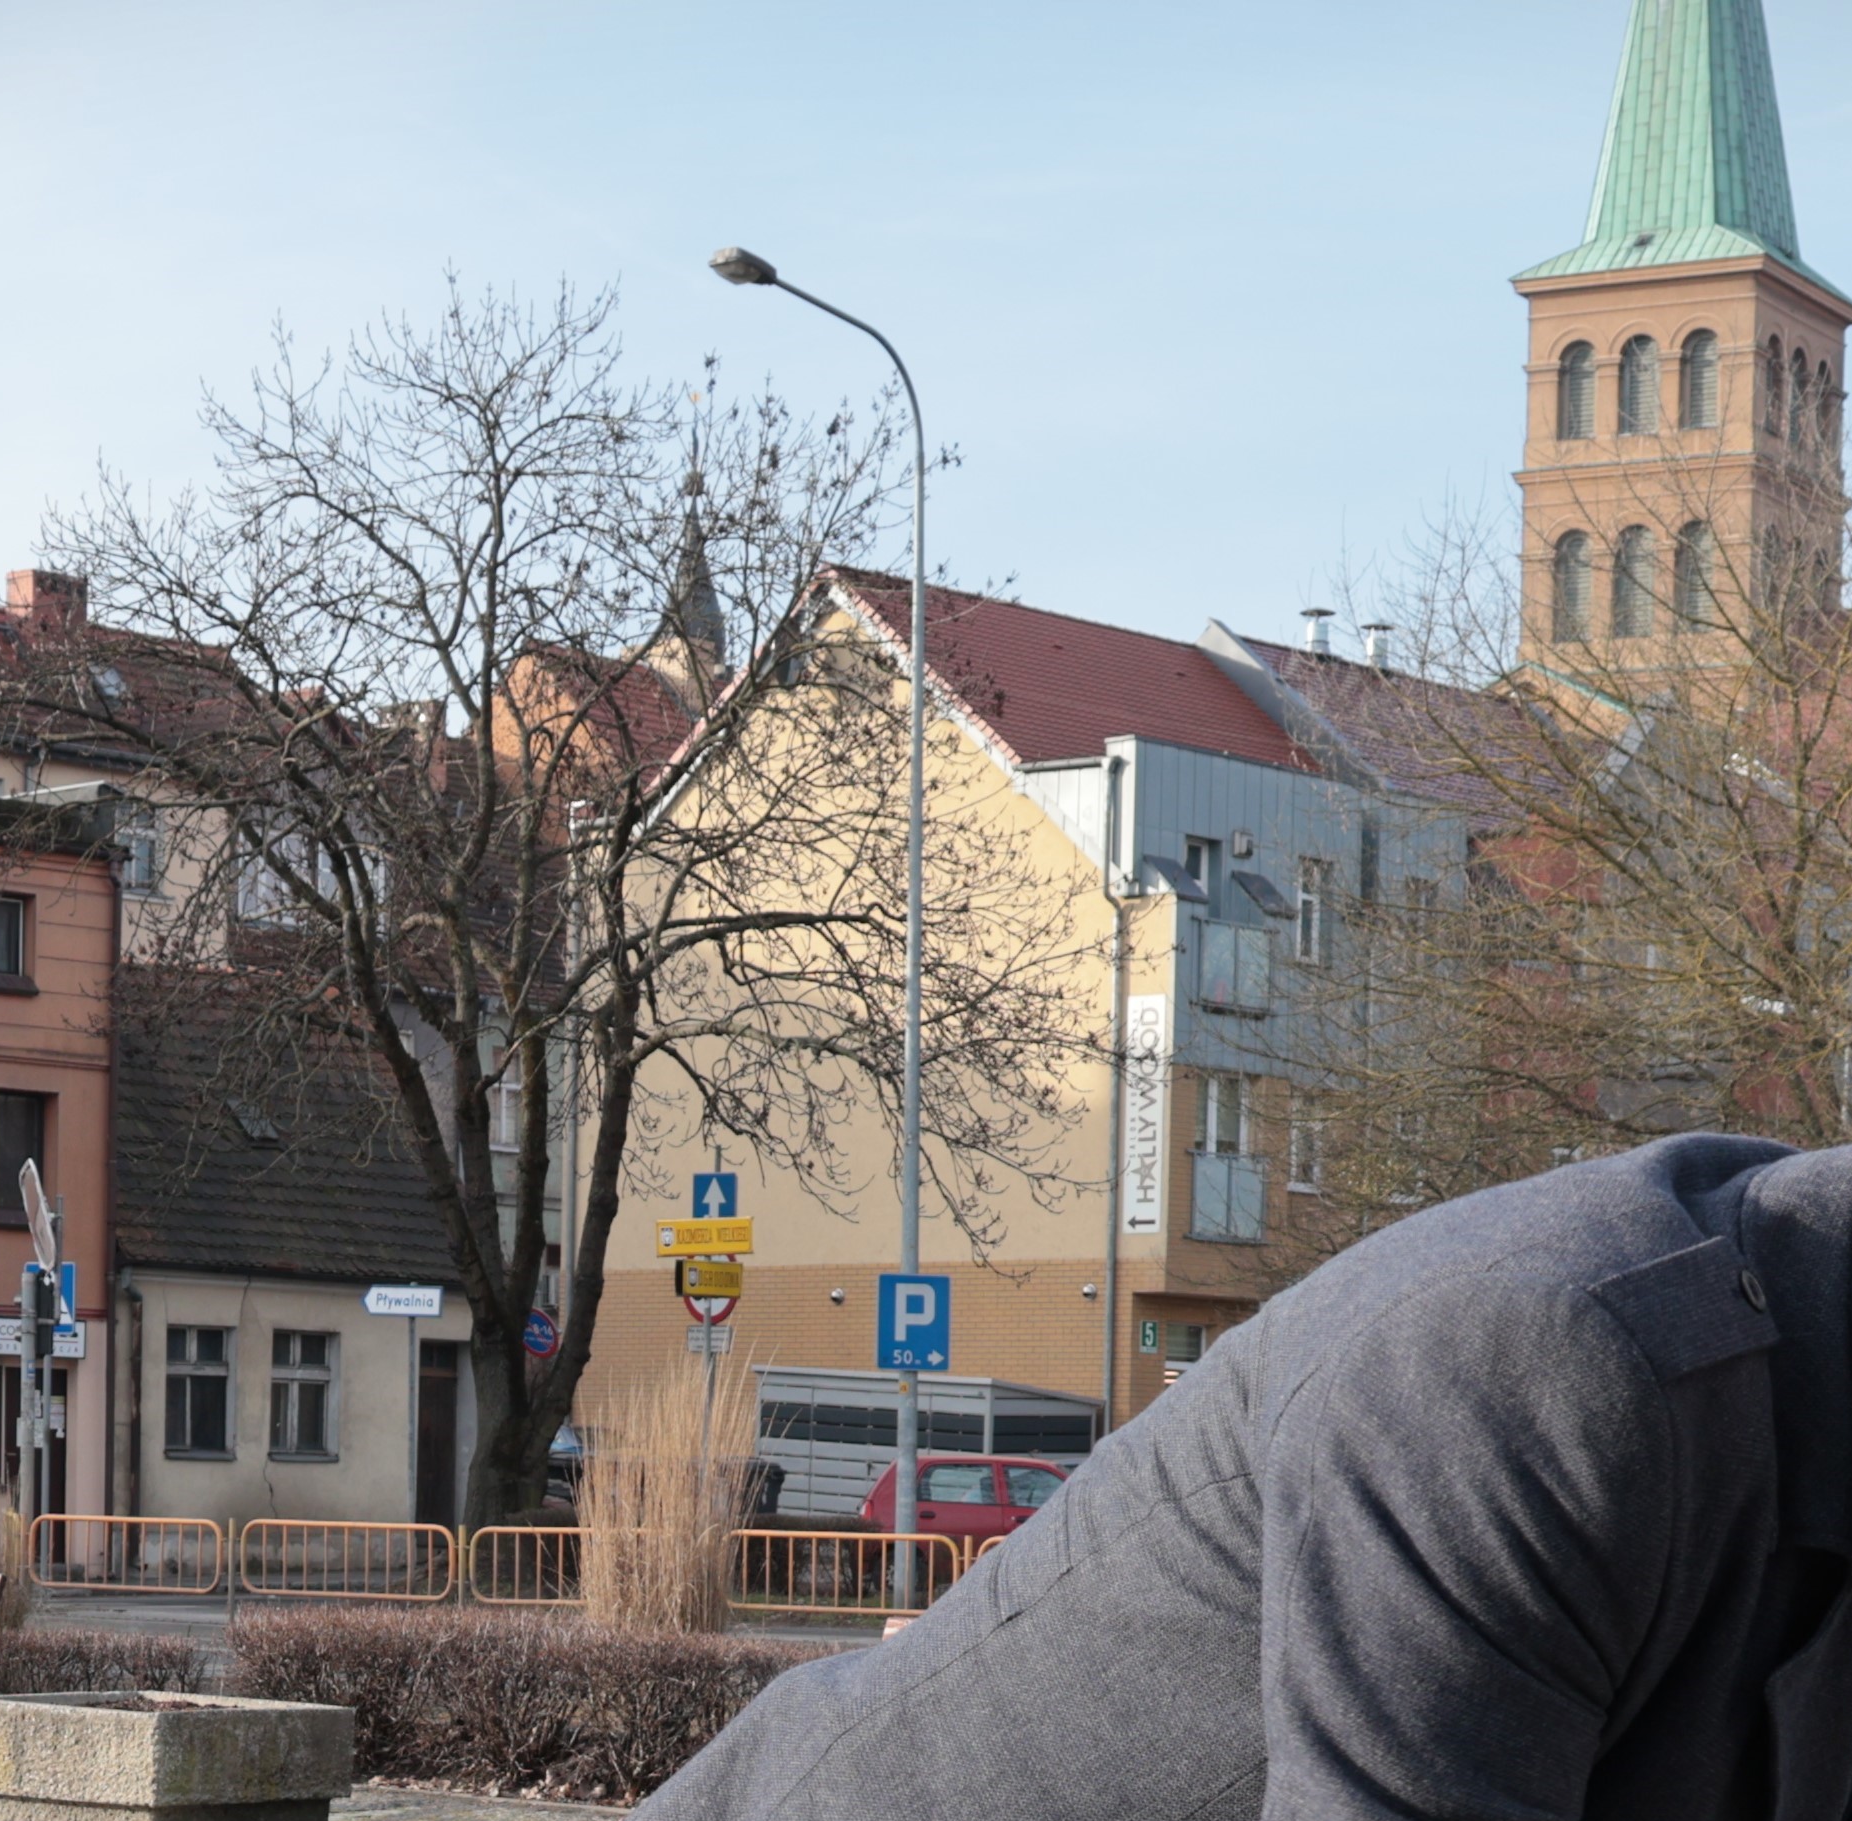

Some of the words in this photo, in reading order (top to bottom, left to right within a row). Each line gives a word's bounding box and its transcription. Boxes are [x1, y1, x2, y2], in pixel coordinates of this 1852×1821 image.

[1129, 1117, 1137, 1159] SALON
[376, 1293, 434, 1310] Pływalnia
[894, 1282, 936, 1342] P
[1145, 1322, 1154, 1347] 5
